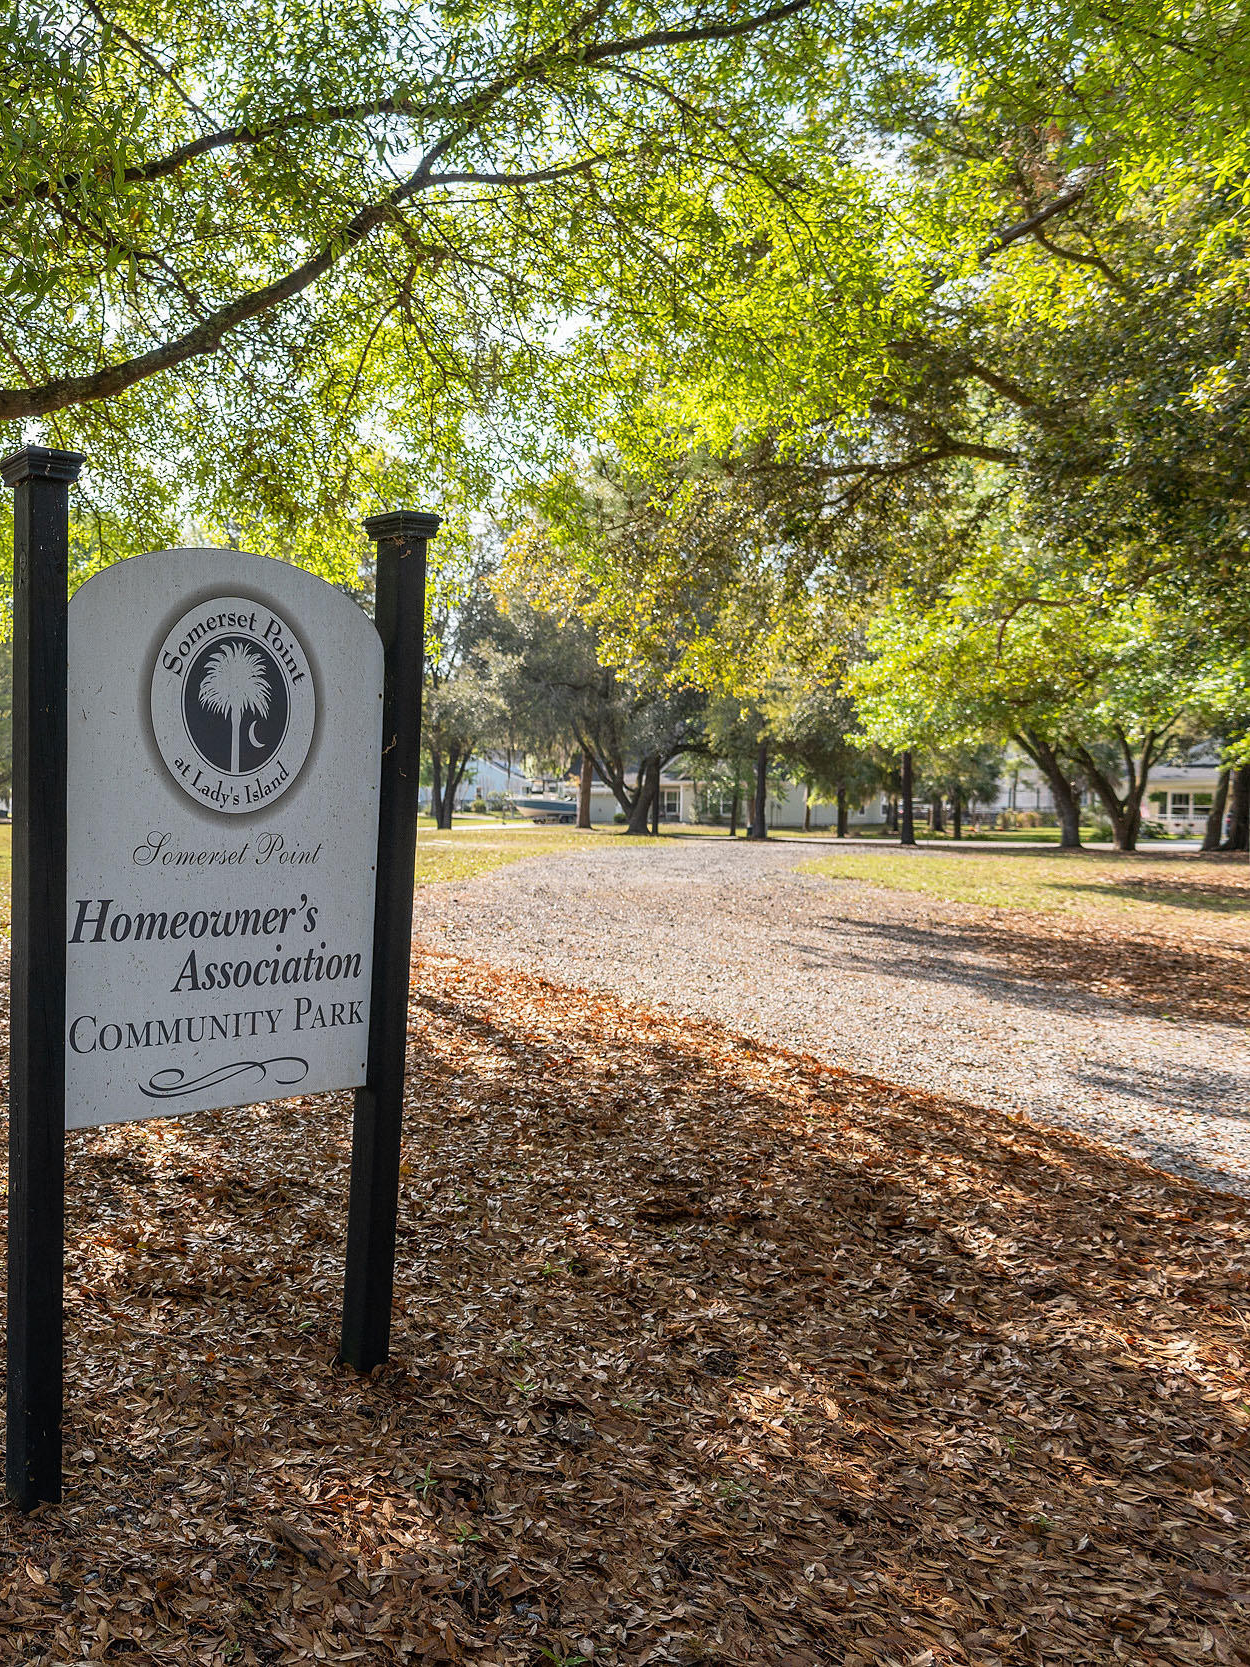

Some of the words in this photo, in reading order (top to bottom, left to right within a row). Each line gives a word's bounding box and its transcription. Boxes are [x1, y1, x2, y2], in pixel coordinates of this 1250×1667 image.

[162, 612, 257, 677] Somerset
[261, 617, 305, 685] Point
[174, 757, 192, 778] at
[191, 769, 240, 808] Lady's
[244, 760, 290, 804] Island
[132, 830, 250, 866] Somerset
[255, 832, 323, 865] Point
[68, 894, 318, 943] Homeowner’s
[170, 942, 362, 992] Association
[69, 1009, 283, 1054] COMMUNITY
[292, 997, 364, 1031] PARK
